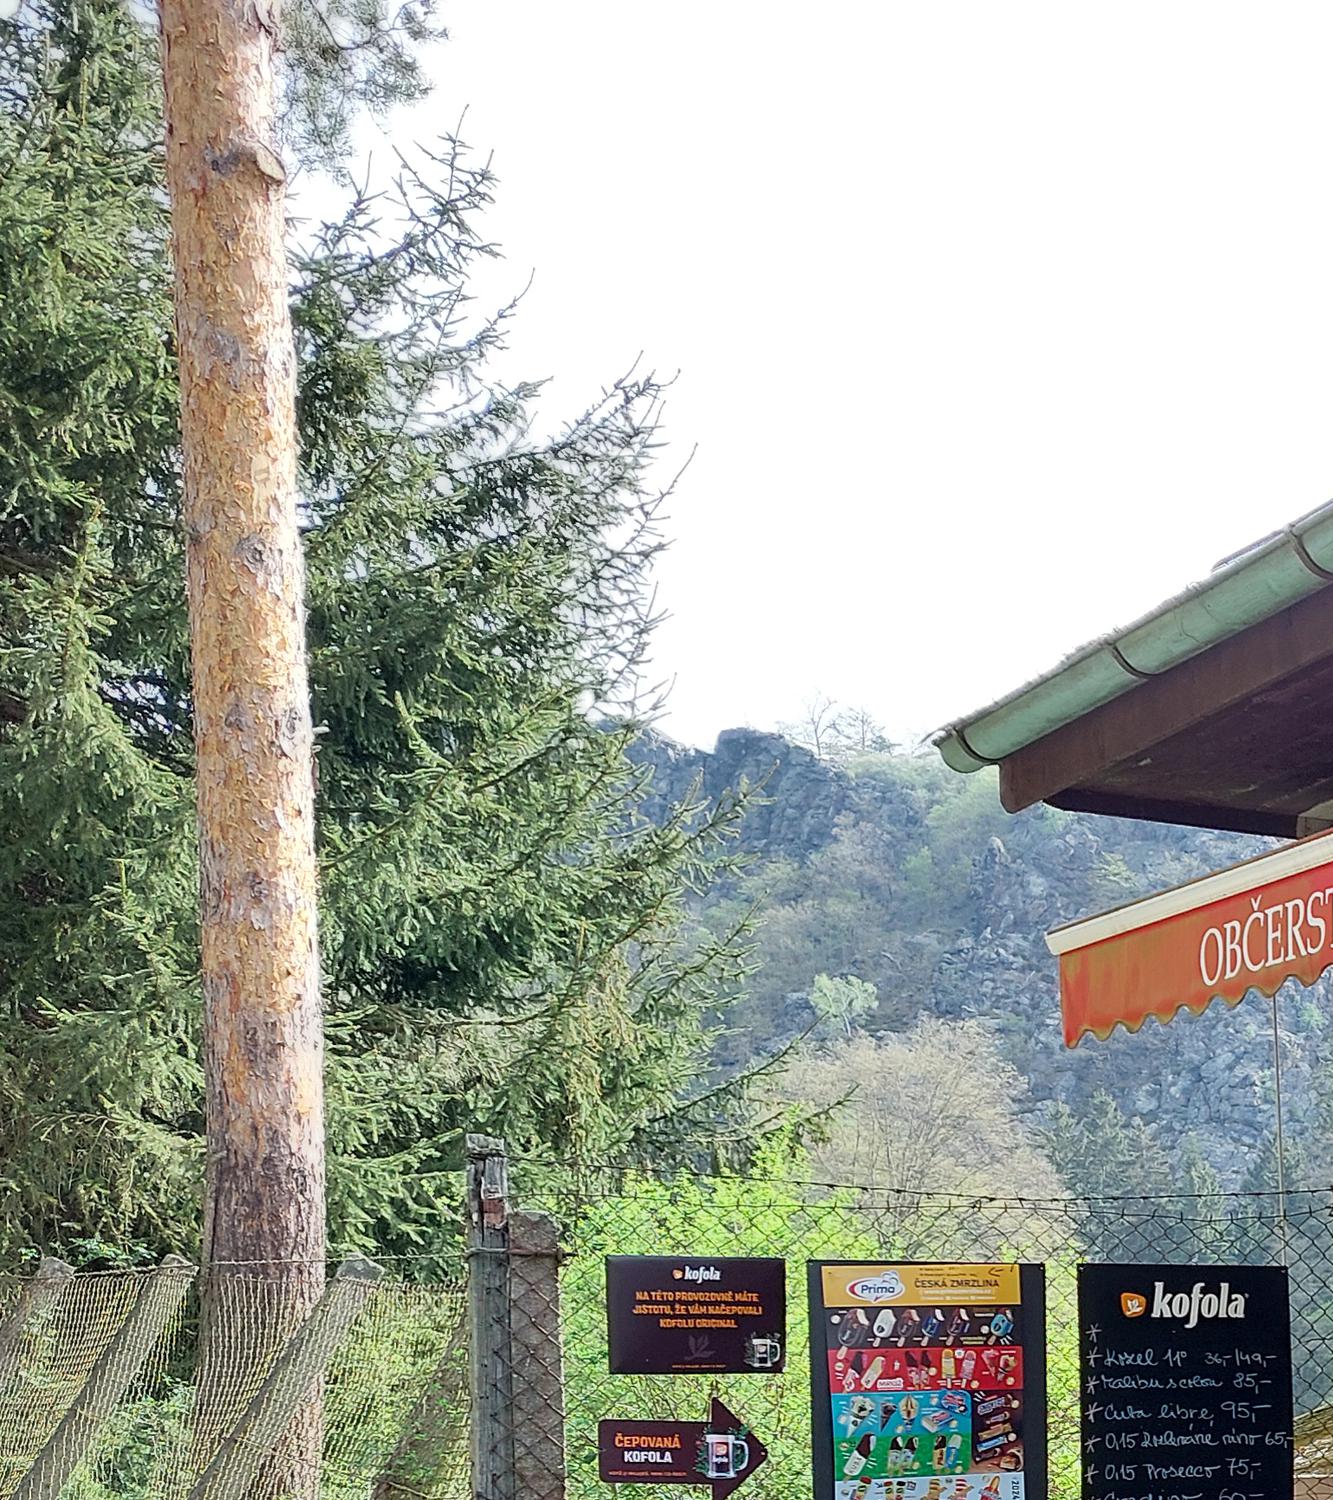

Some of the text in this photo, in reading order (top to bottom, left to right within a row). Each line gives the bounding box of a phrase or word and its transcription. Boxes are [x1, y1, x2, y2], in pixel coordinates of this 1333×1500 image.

[684, 1265, 722, 1284] kofola
[860, 1277, 1000, 1294] Prima ČESKÁ ZMRZLINA
[635, 1290, 650, 1301] NA
[1151, 1281, 1246, 1329] kofola
[1104, 1348, 1159, 1367] Kozel
[614, 1432, 681, 1449] ČEPOVANÁ
[623, 1450, 673, 1463] KOFOLA
[1011, 1479, 1020, 1500] 2024
